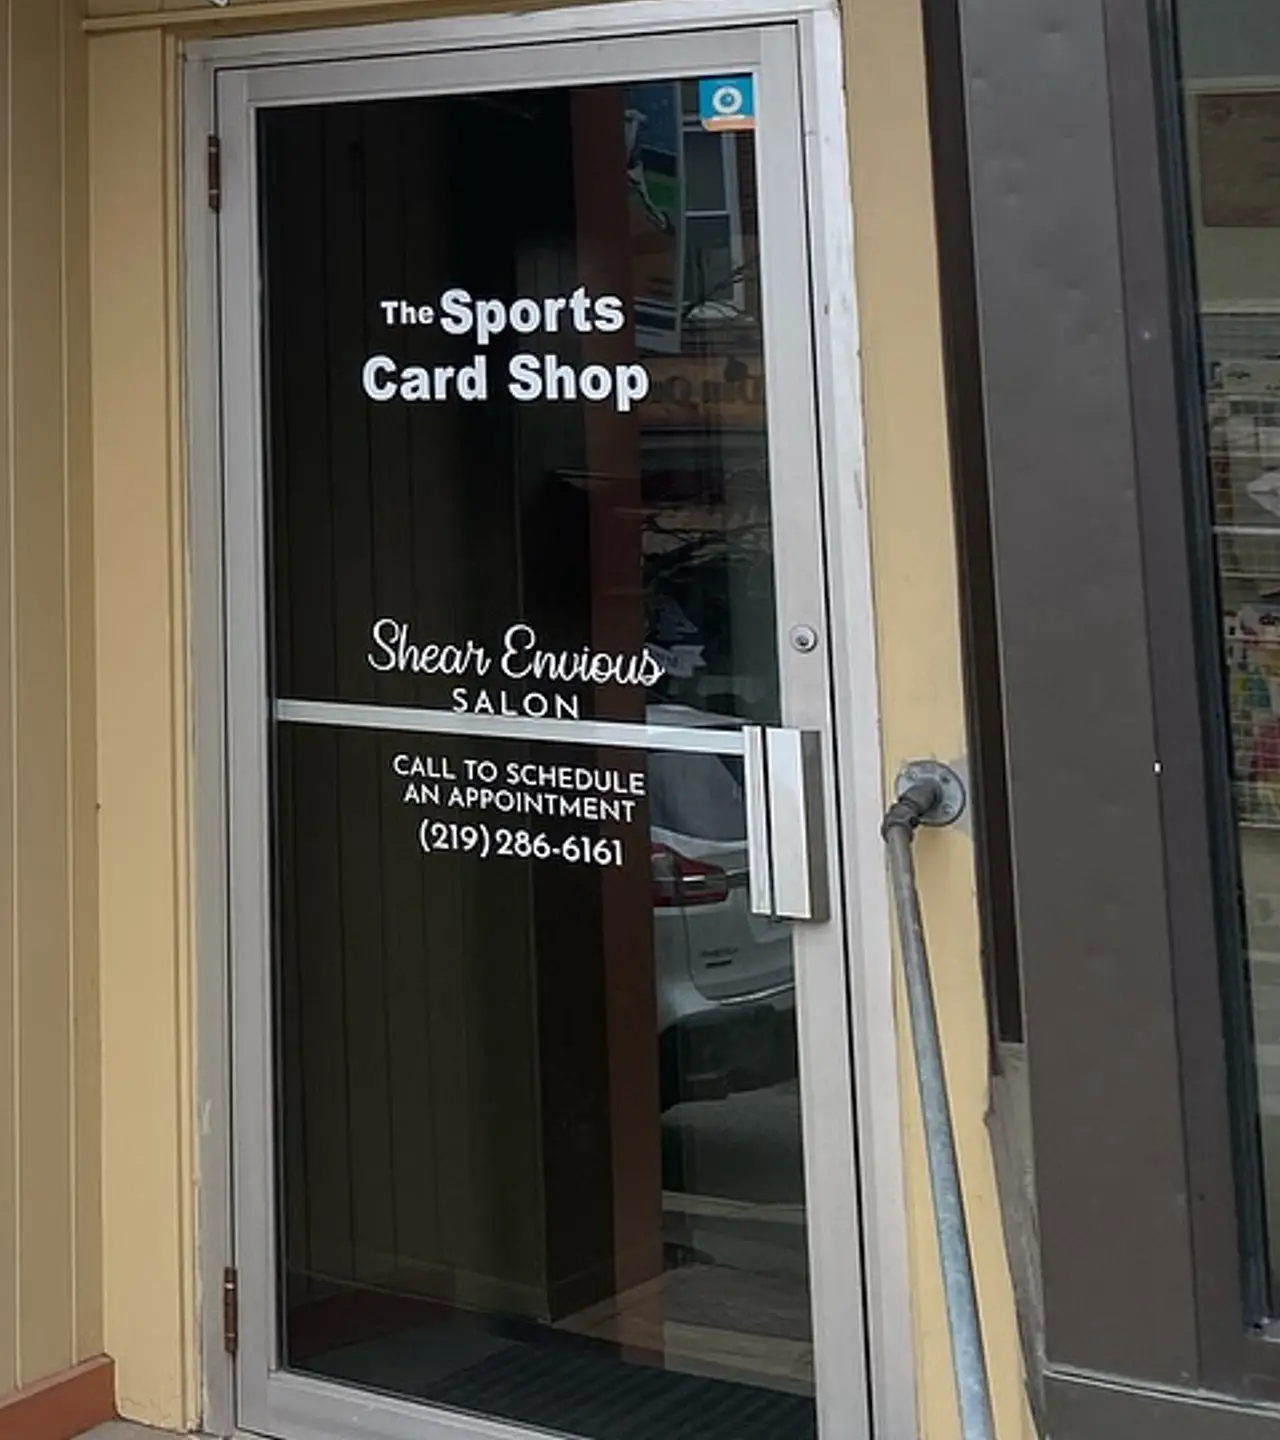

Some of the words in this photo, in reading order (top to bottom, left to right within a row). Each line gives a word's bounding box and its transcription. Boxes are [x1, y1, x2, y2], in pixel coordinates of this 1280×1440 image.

[381, 299, 434, 325] The
[439, 287, 624, 345] Sports
[362, 356, 487, 402] Card
[508, 354, 649, 411] Shop
[367, 618, 491, 678] Shear
[501, 623, 666, 686] Envious
[451, 688, 579, 720] SALON
[393, 754, 457, 782] CALL
[464, 760, 498, 784] TO
[506, 762, 646, 795] SCHEDULE
[404, 783, 440, 806] AN
[448, 787, 637, 823] APPOINTMENT
